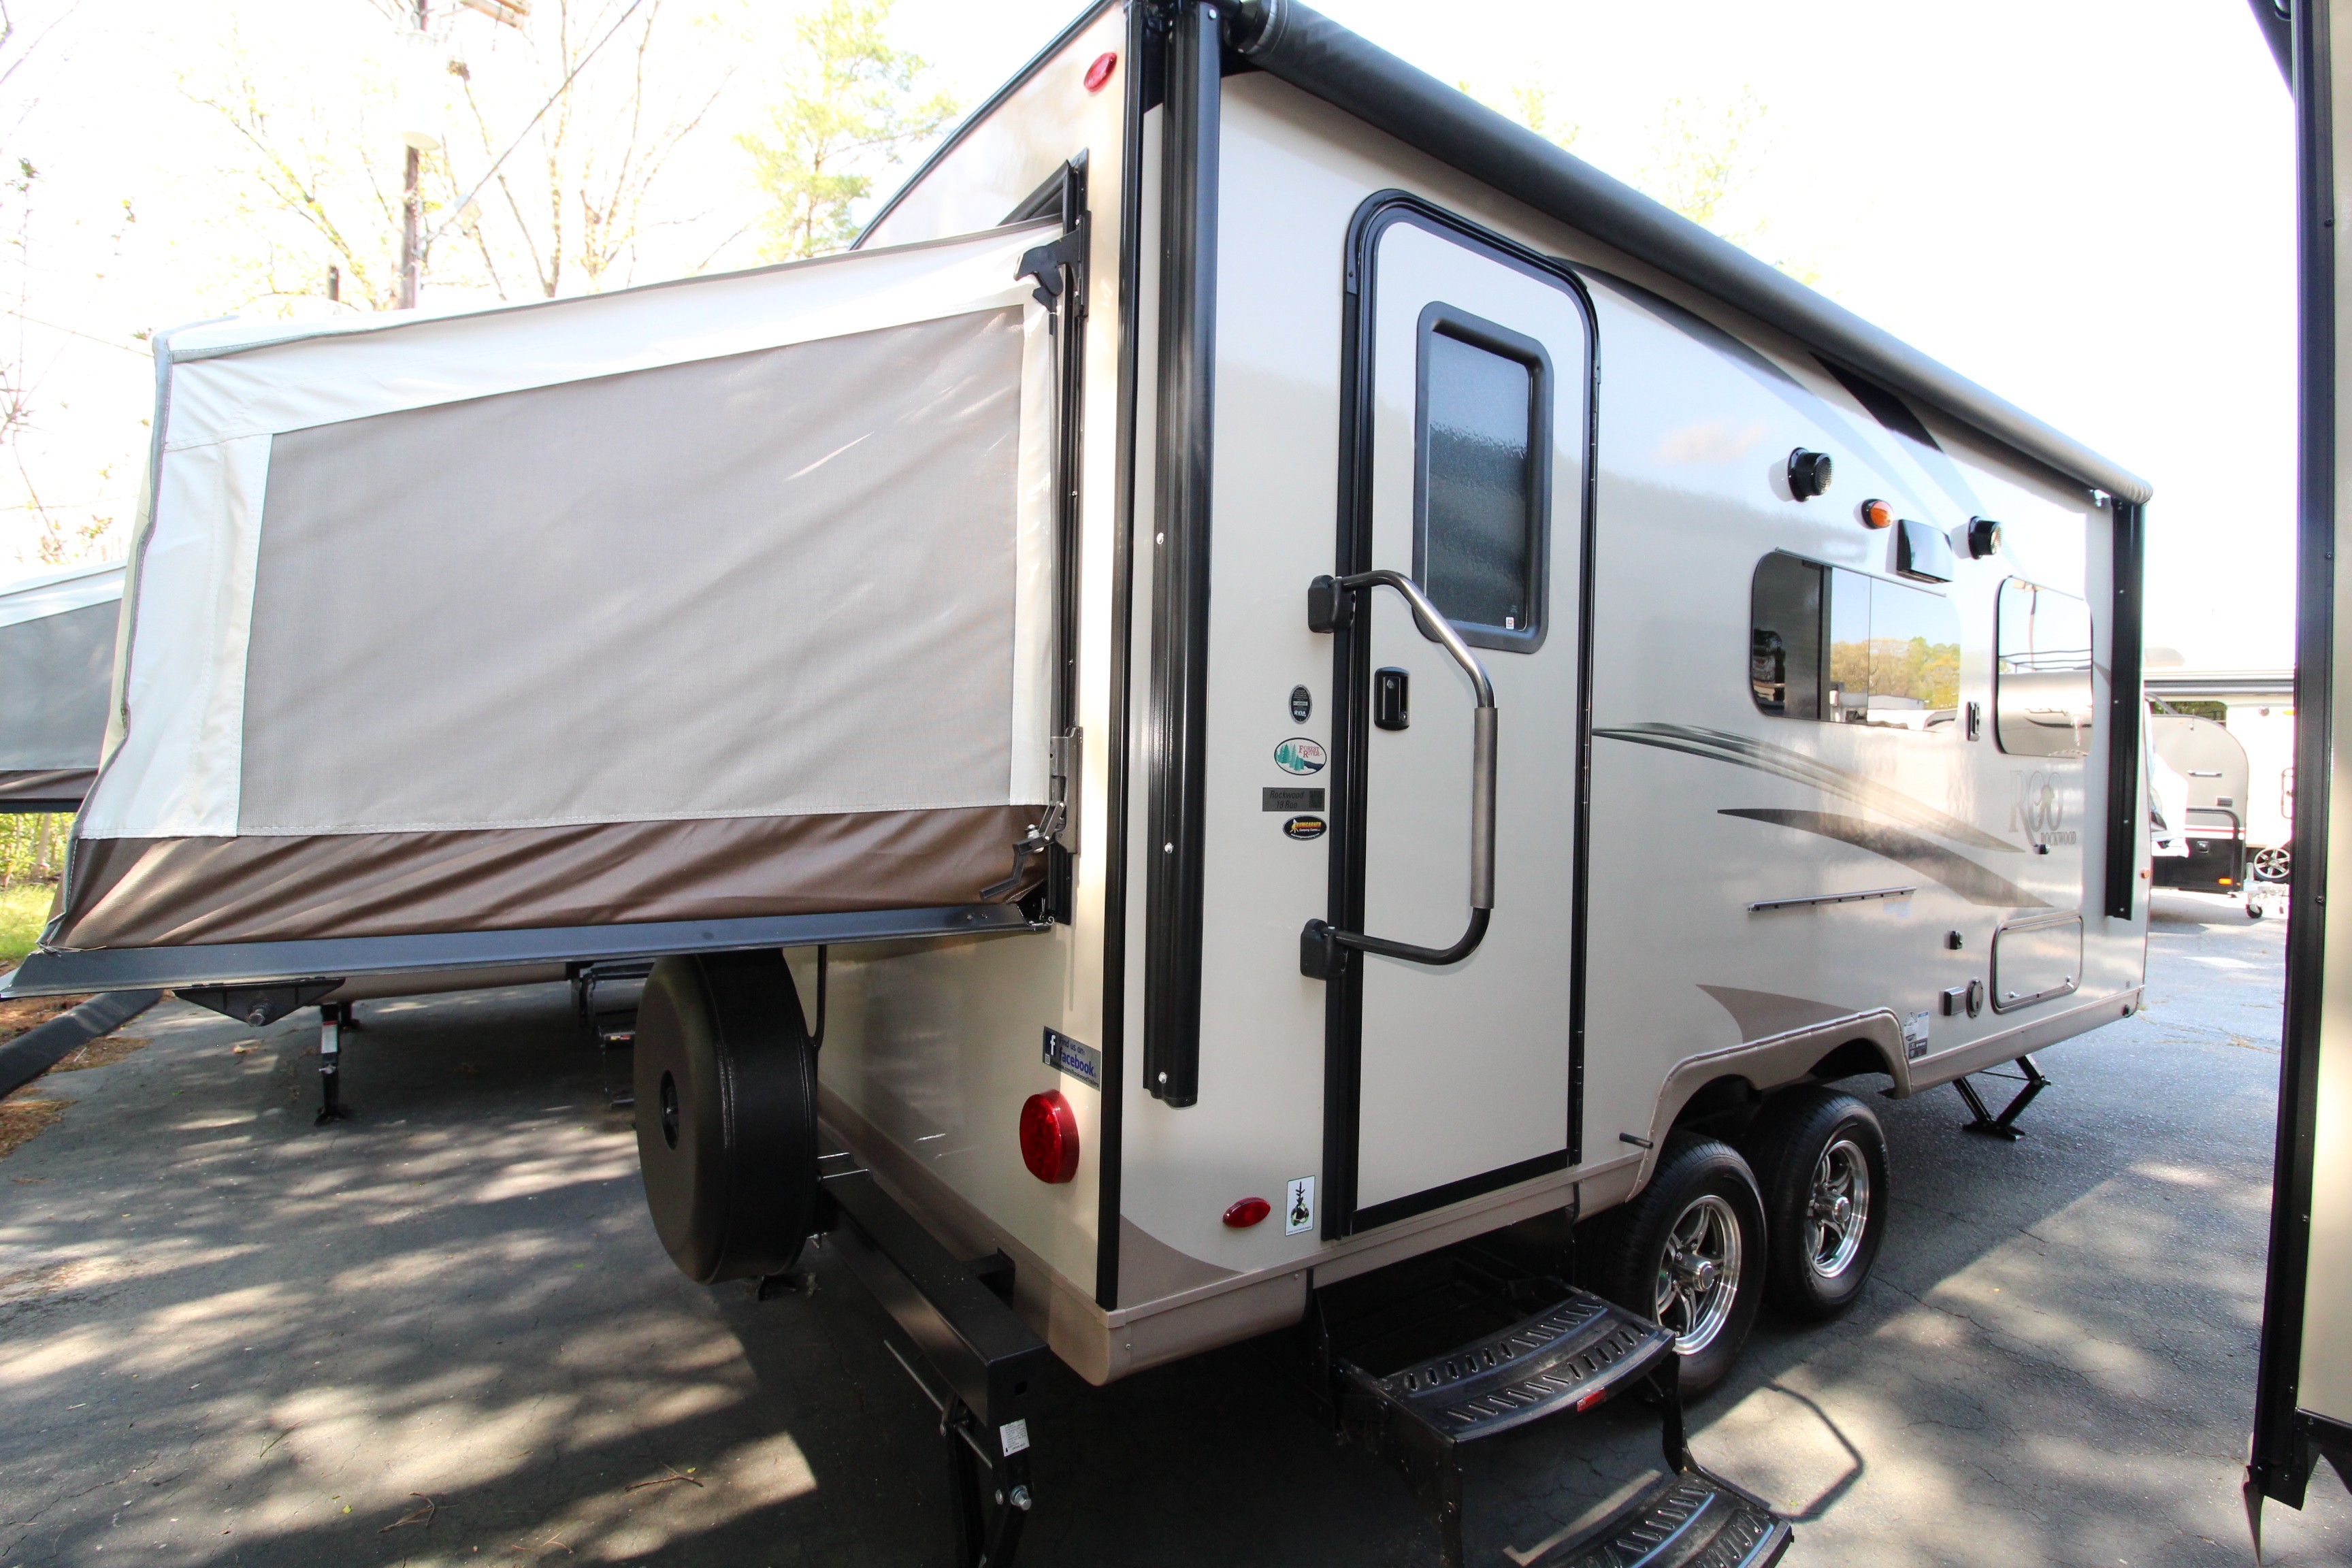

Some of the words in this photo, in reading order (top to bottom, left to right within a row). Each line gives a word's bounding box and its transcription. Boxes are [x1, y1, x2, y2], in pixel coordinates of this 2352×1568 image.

[1303, 750, 1320, 758] RIVER
[1270, 790, 1305, 799] Rockwood
[1277, 800, 1284, 808] 19
[1285, 800, 1298, 808] Roo
[2041, 831, 2077, 846] ROCKWOOD
[1060, 1036, 1069, 1047] Find
[1070, 1043, 1077, 1051] us
